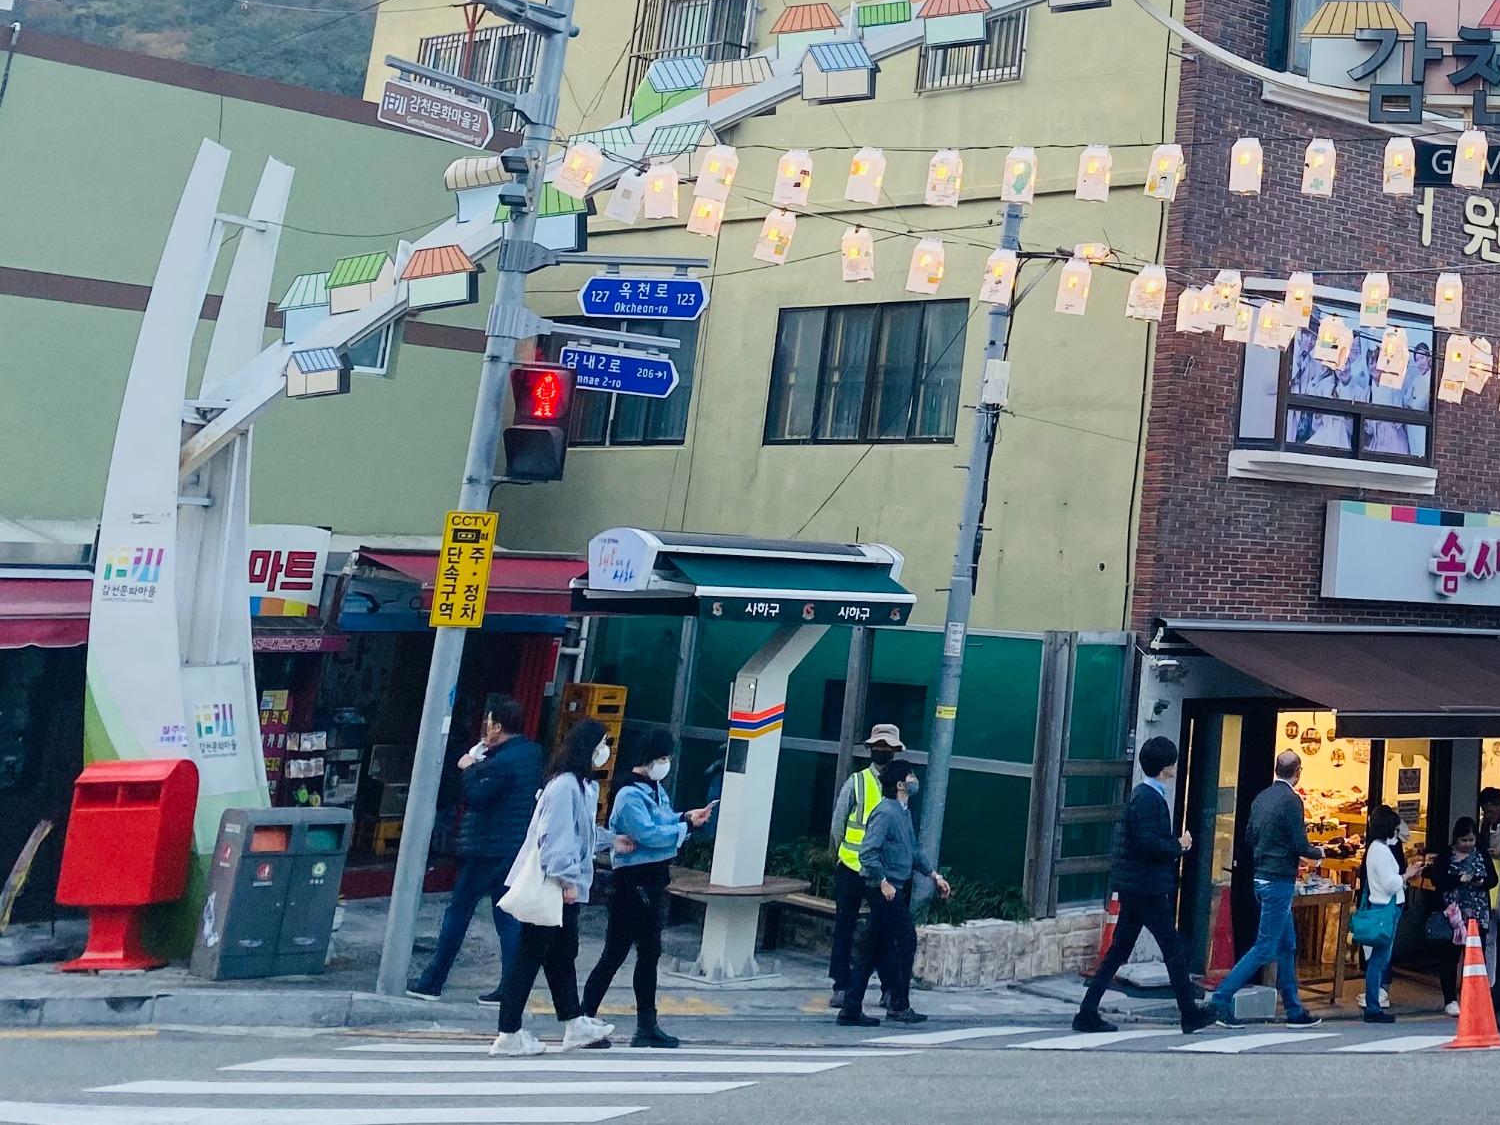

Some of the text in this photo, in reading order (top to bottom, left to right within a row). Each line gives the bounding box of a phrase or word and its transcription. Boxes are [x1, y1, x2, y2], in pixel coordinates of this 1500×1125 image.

[409, 94, 482, 133] 감천문화마을길
[591, 281, 696, 306] 127 옥천로 123
[614, 301, 669, 314] Okcheon-ro
[565, 352, 622, 373] 감내2로
[636, 367, 654, 379] 206
[602, 376, 622, 388] 2-ro
[451, 515, 491, 527] CCTV
[248, 549, 318, 593] 마트
[102, 584, 157, 598] 감천문화마을
[439, 546, 463, 621] 단속구역
[745, 601, 871, 621] 사하구 사하구
